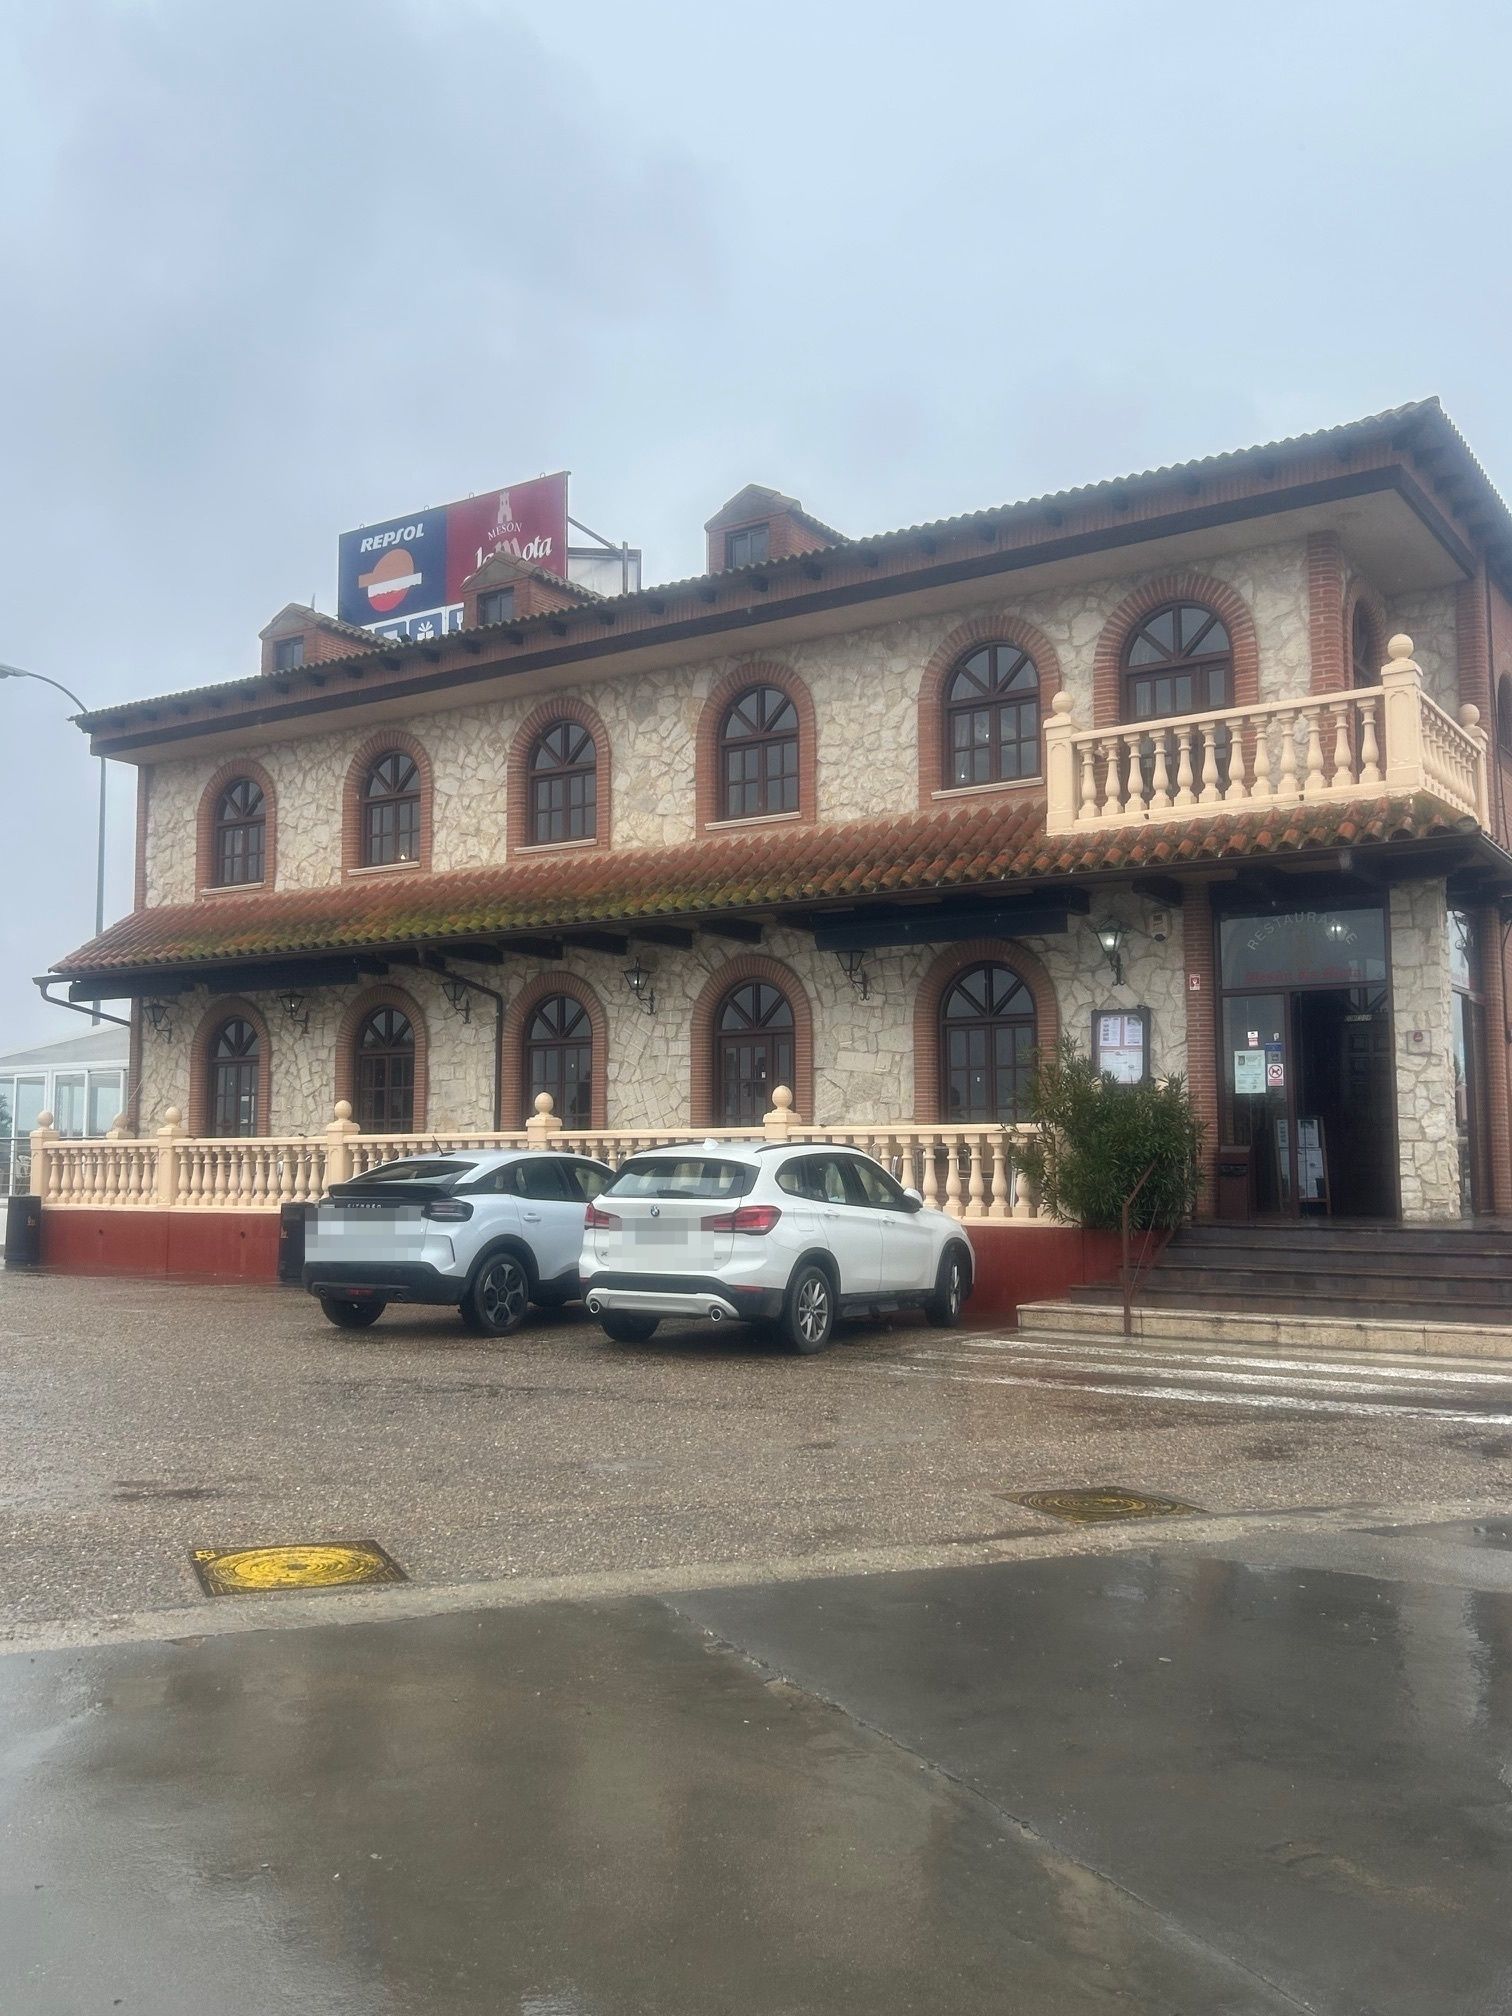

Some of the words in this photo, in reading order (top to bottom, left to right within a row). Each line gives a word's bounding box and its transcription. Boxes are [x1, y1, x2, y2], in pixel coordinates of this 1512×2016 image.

[360, 523, 424, 553] REPSOL
[495, 535, 553, 562] Mota
[1247, 911, 1358, 950] RESTAURAE
